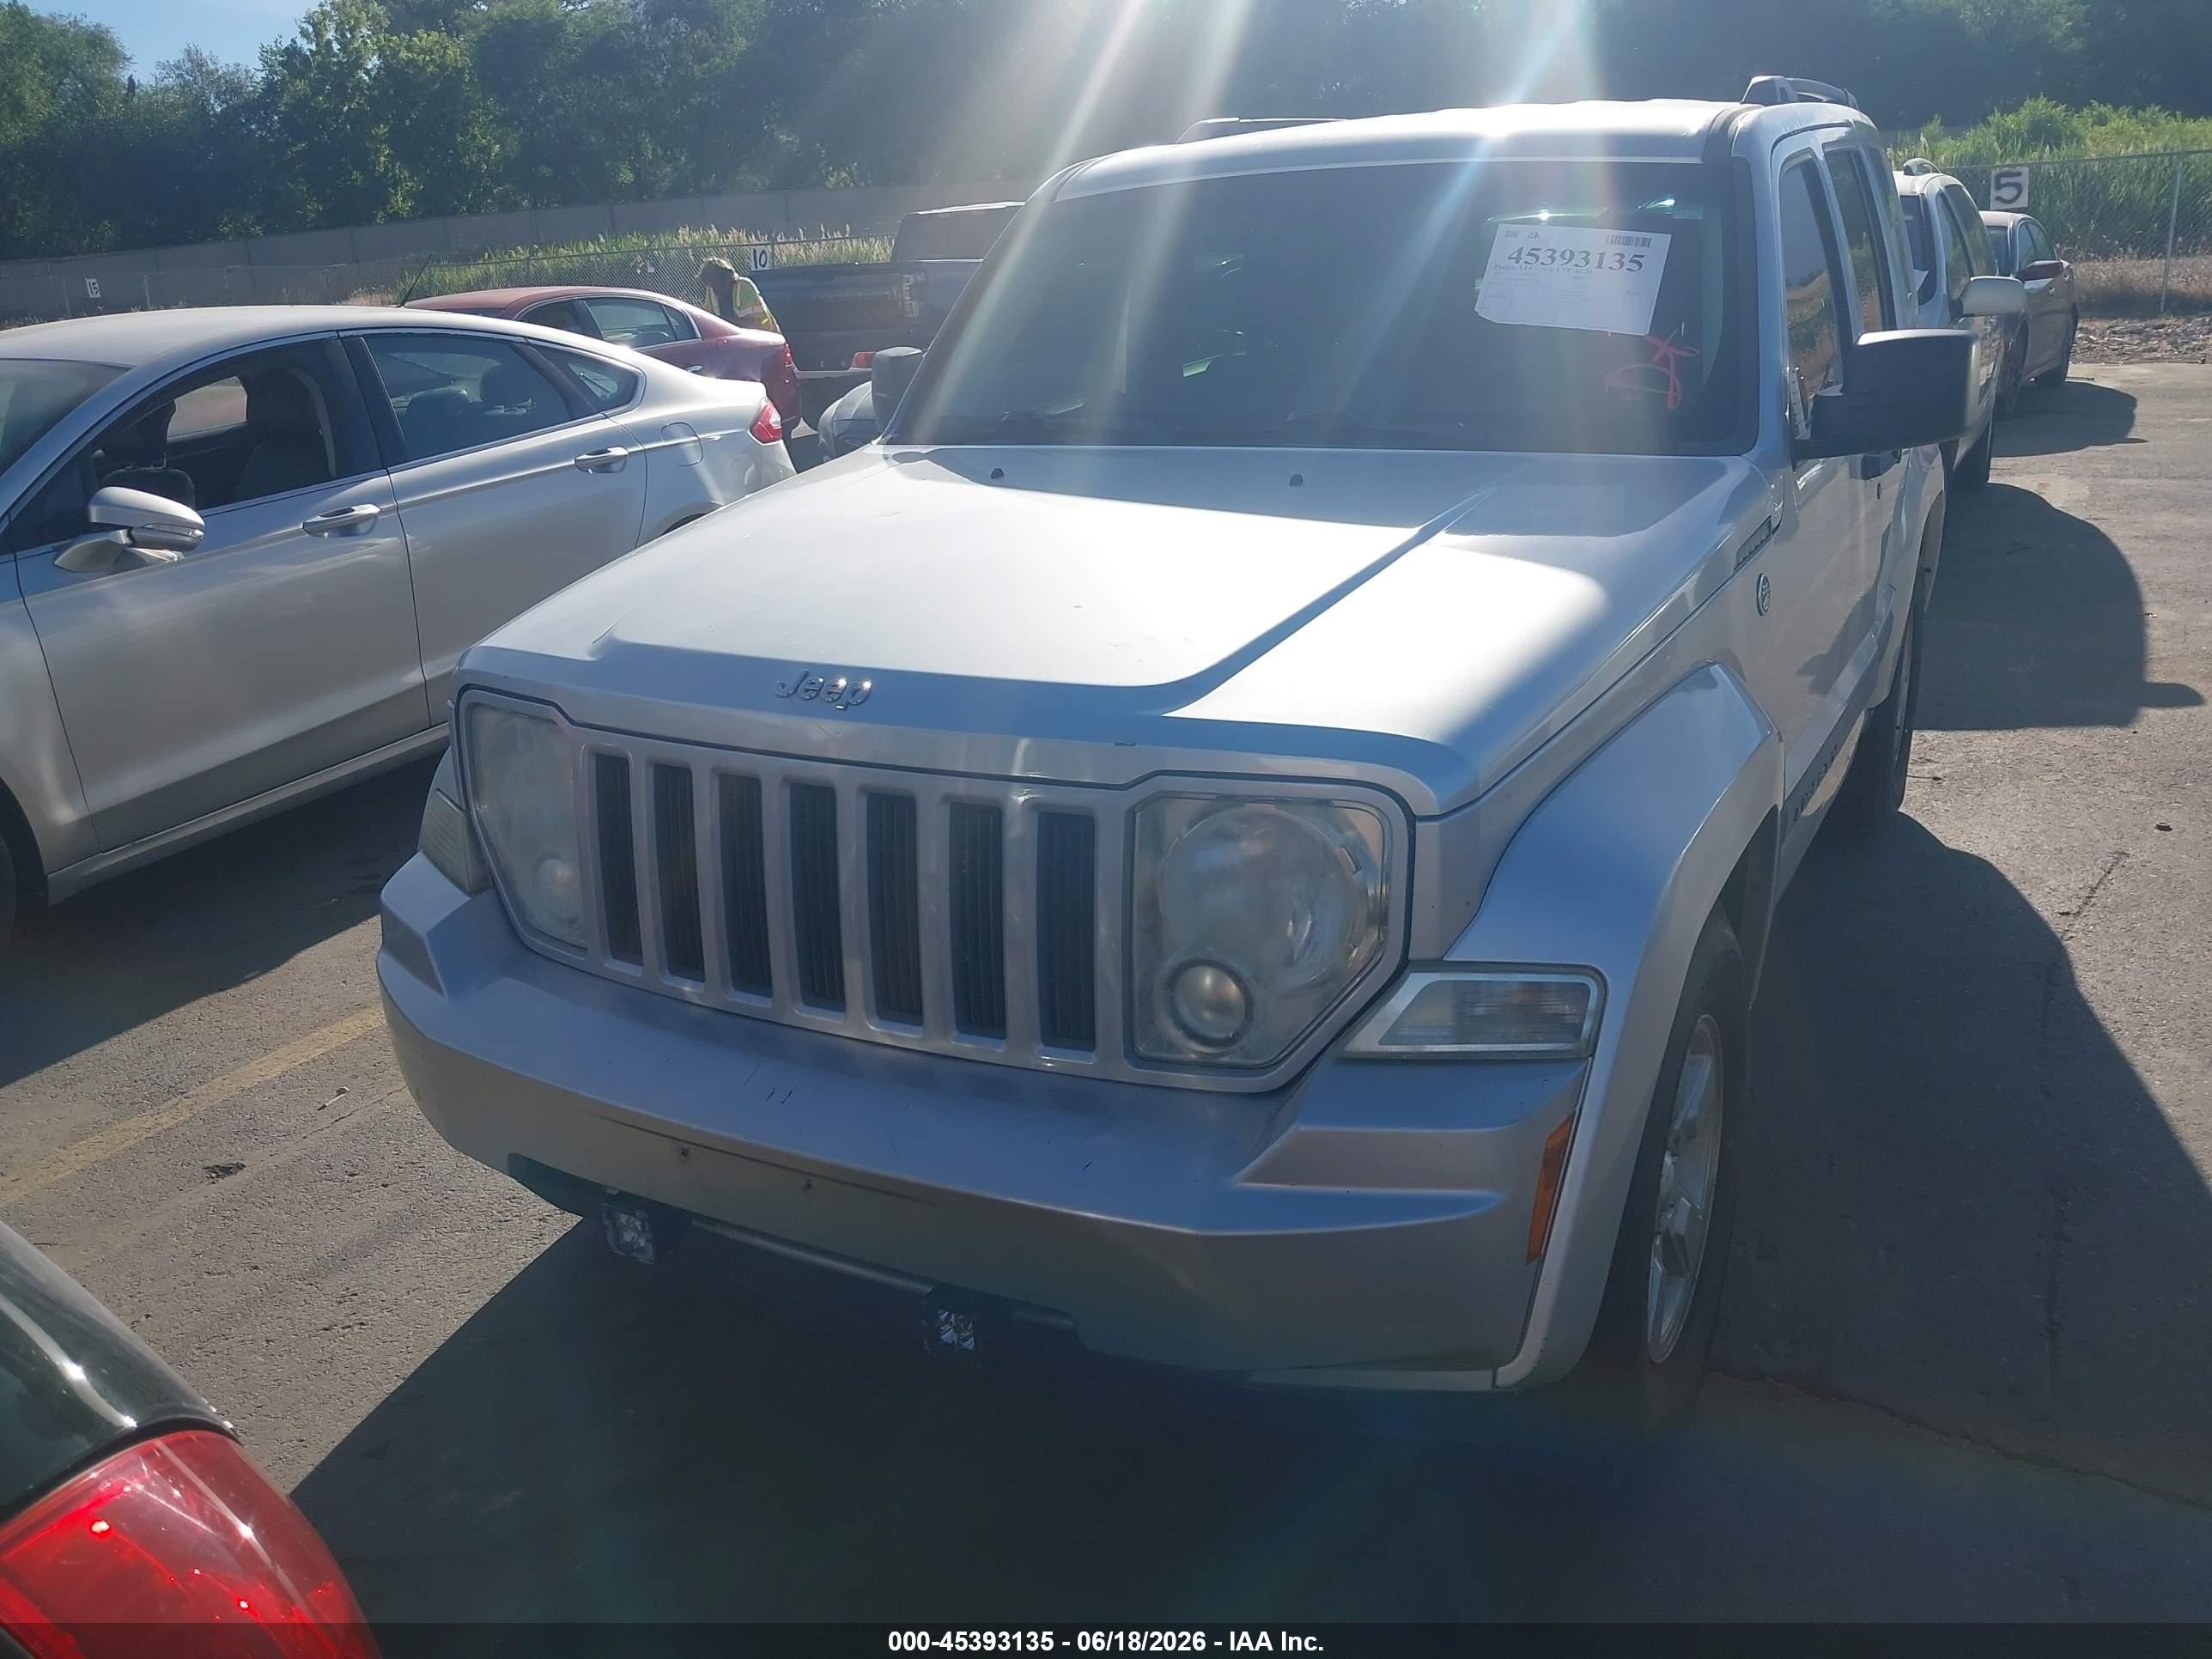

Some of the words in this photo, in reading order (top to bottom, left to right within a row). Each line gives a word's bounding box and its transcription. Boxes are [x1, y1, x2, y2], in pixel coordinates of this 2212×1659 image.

[1994, 171, 2023, 204] 5
[752, 248, 768, 270] 10
[1506, 246, 1645, 272] 45393135
[773, 669, 873, 710] Jeep
